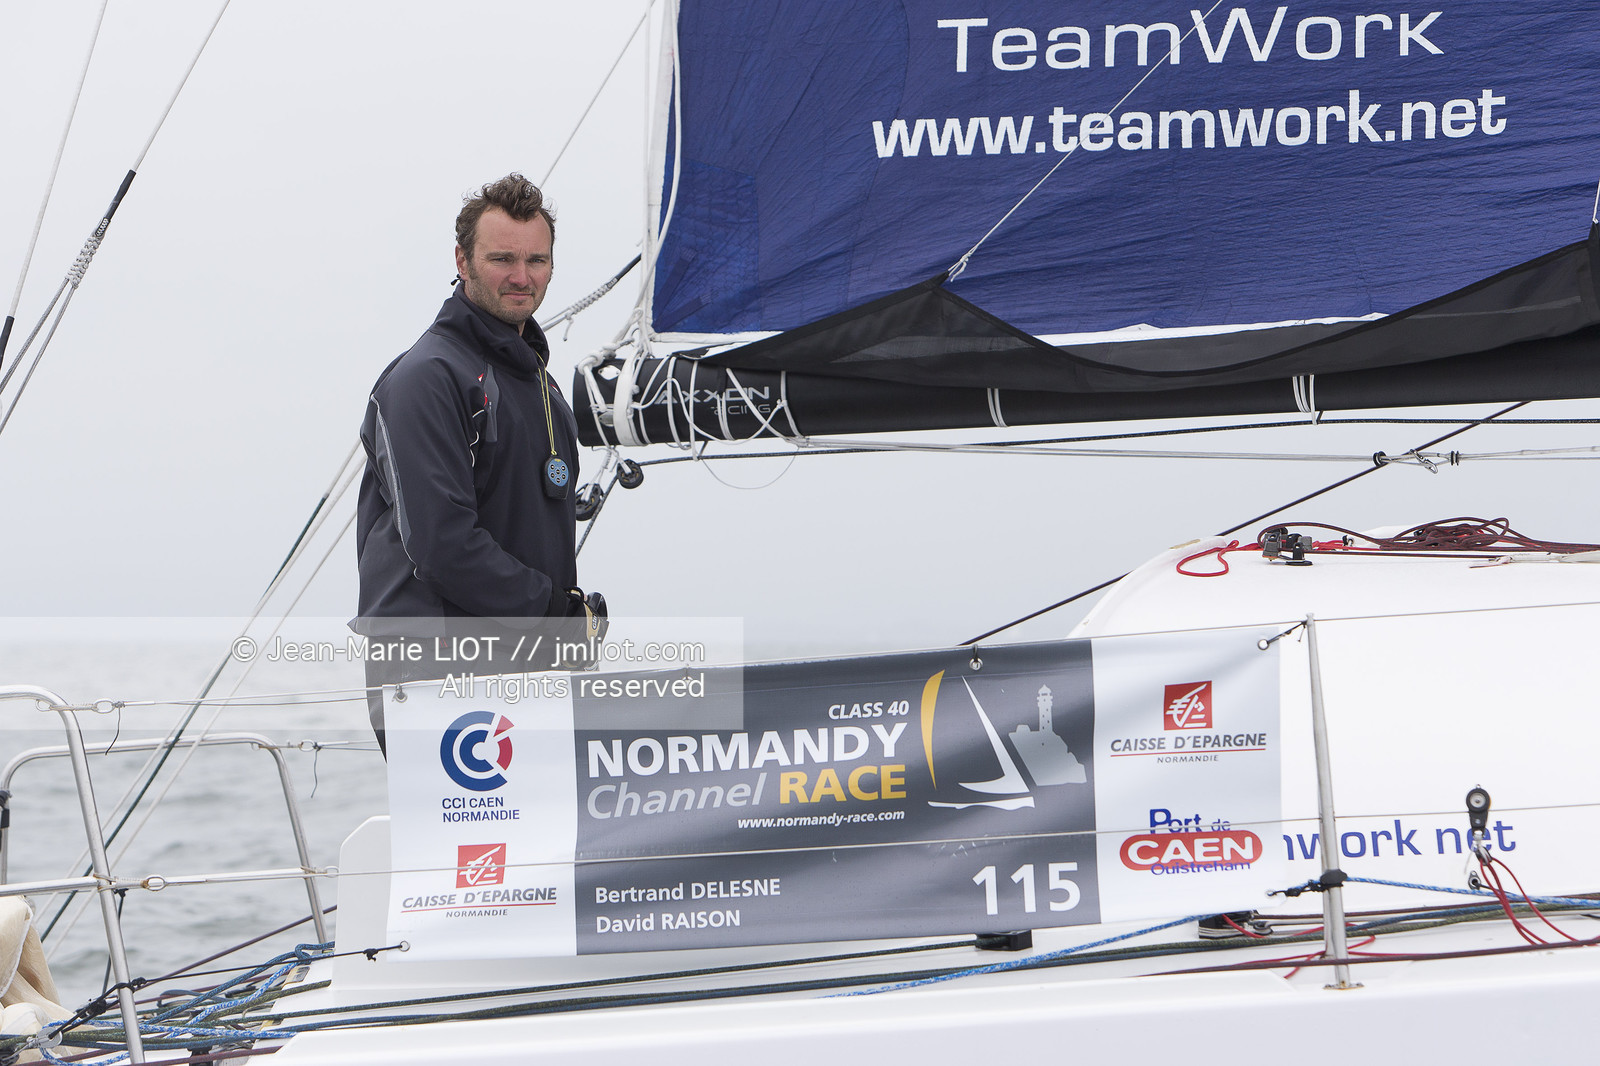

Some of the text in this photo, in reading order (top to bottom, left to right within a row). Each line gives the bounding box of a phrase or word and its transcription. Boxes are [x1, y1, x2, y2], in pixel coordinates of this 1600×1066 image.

[872, 89, 1507, 158] www.teamwork.net
[828, 701, 910, 720] CLASS 40
[587, 722, 908, 778] NORMANDY
[1110, 737, 1166, 752] CAISSE
[1157, 755, 1219, 763] NORMANDIE
[587, 764, 907, 819] Channel RACE
[441, 797, 504, 810] CCI CAEN
[442, 810, 520, 823] NORMANDIE
[737, 809, 905, 829] www.normandy-race.com
[1149, 808, 1231, 835] Port de
[1436, 820, 1516, 855] net
[1127, 836, 1254, 865] CAEN
[1151, 861, 1251, 875] Ouistreham
[595, 878, 781, 904] Bertrand DELESNE
[972, 862, 1081, 916] 115
[402, 893, 457, 909] CAISSE
[445, 908, 508, 918] NORMANDIE
[596, 909, 741, 933] David RAISON
